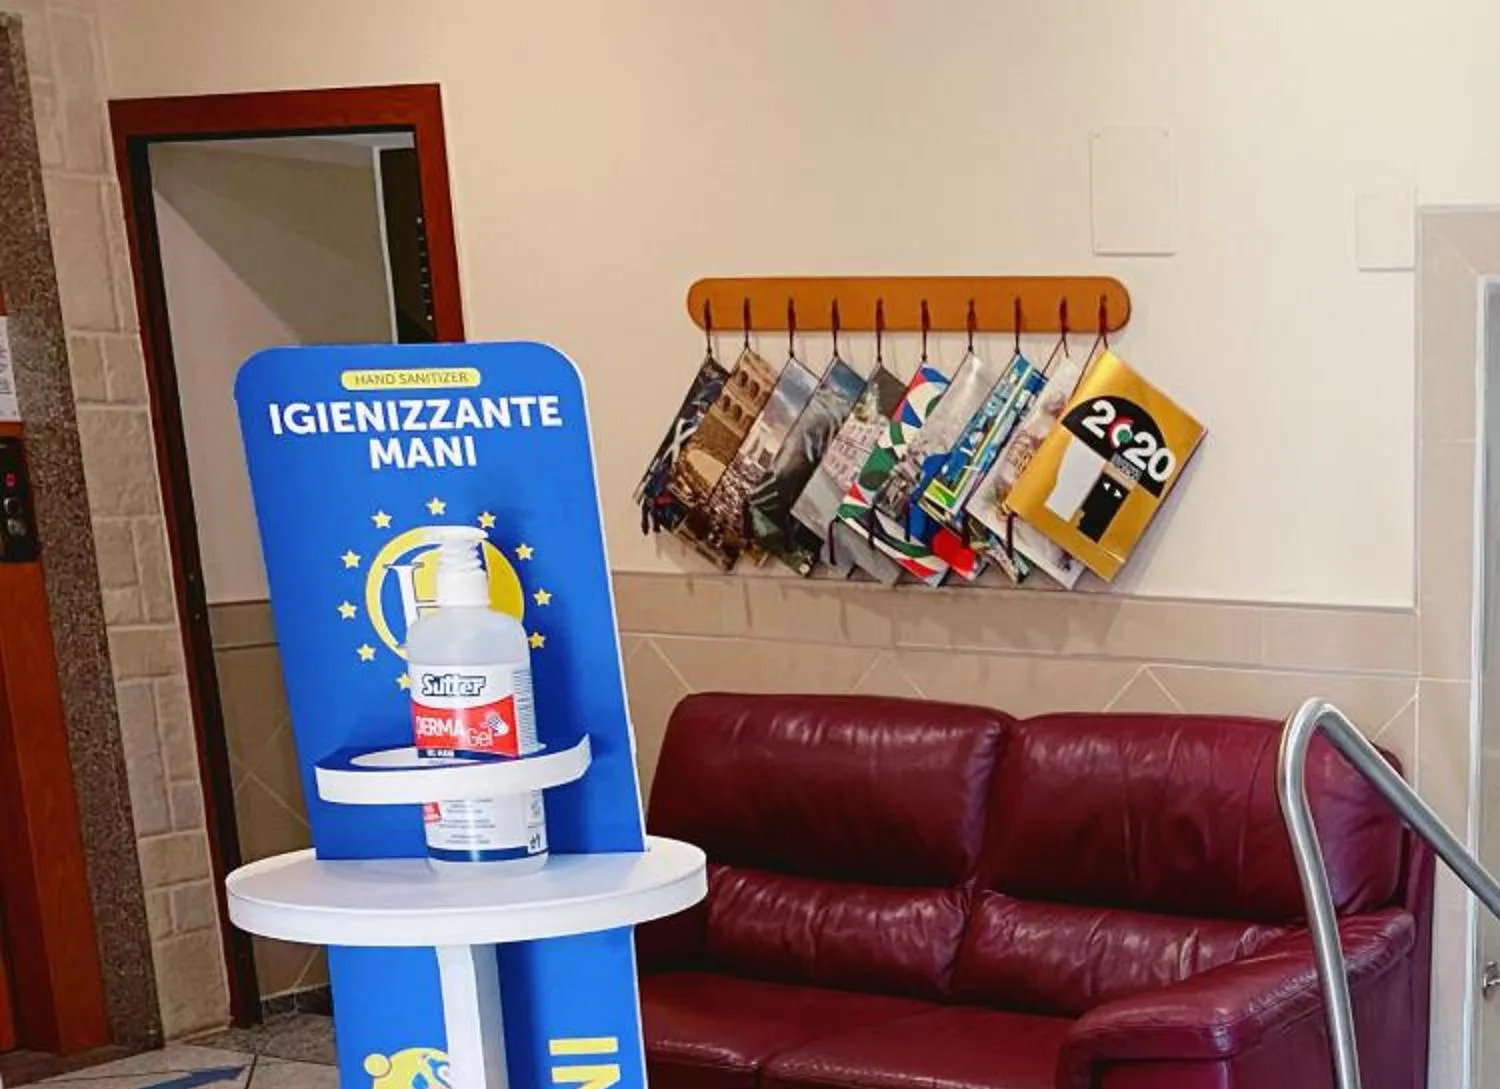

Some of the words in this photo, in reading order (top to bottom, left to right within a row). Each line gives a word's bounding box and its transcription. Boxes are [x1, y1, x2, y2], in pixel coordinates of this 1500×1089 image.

[354, 373, 396, 385] HAND
[399, 370, 470, 384] SANITIZER
[269, 395, 563, 435] IGIENIZZANTE
[368, 435, 477, 469] MANI
[421, 673, 487, 697] Sutter
